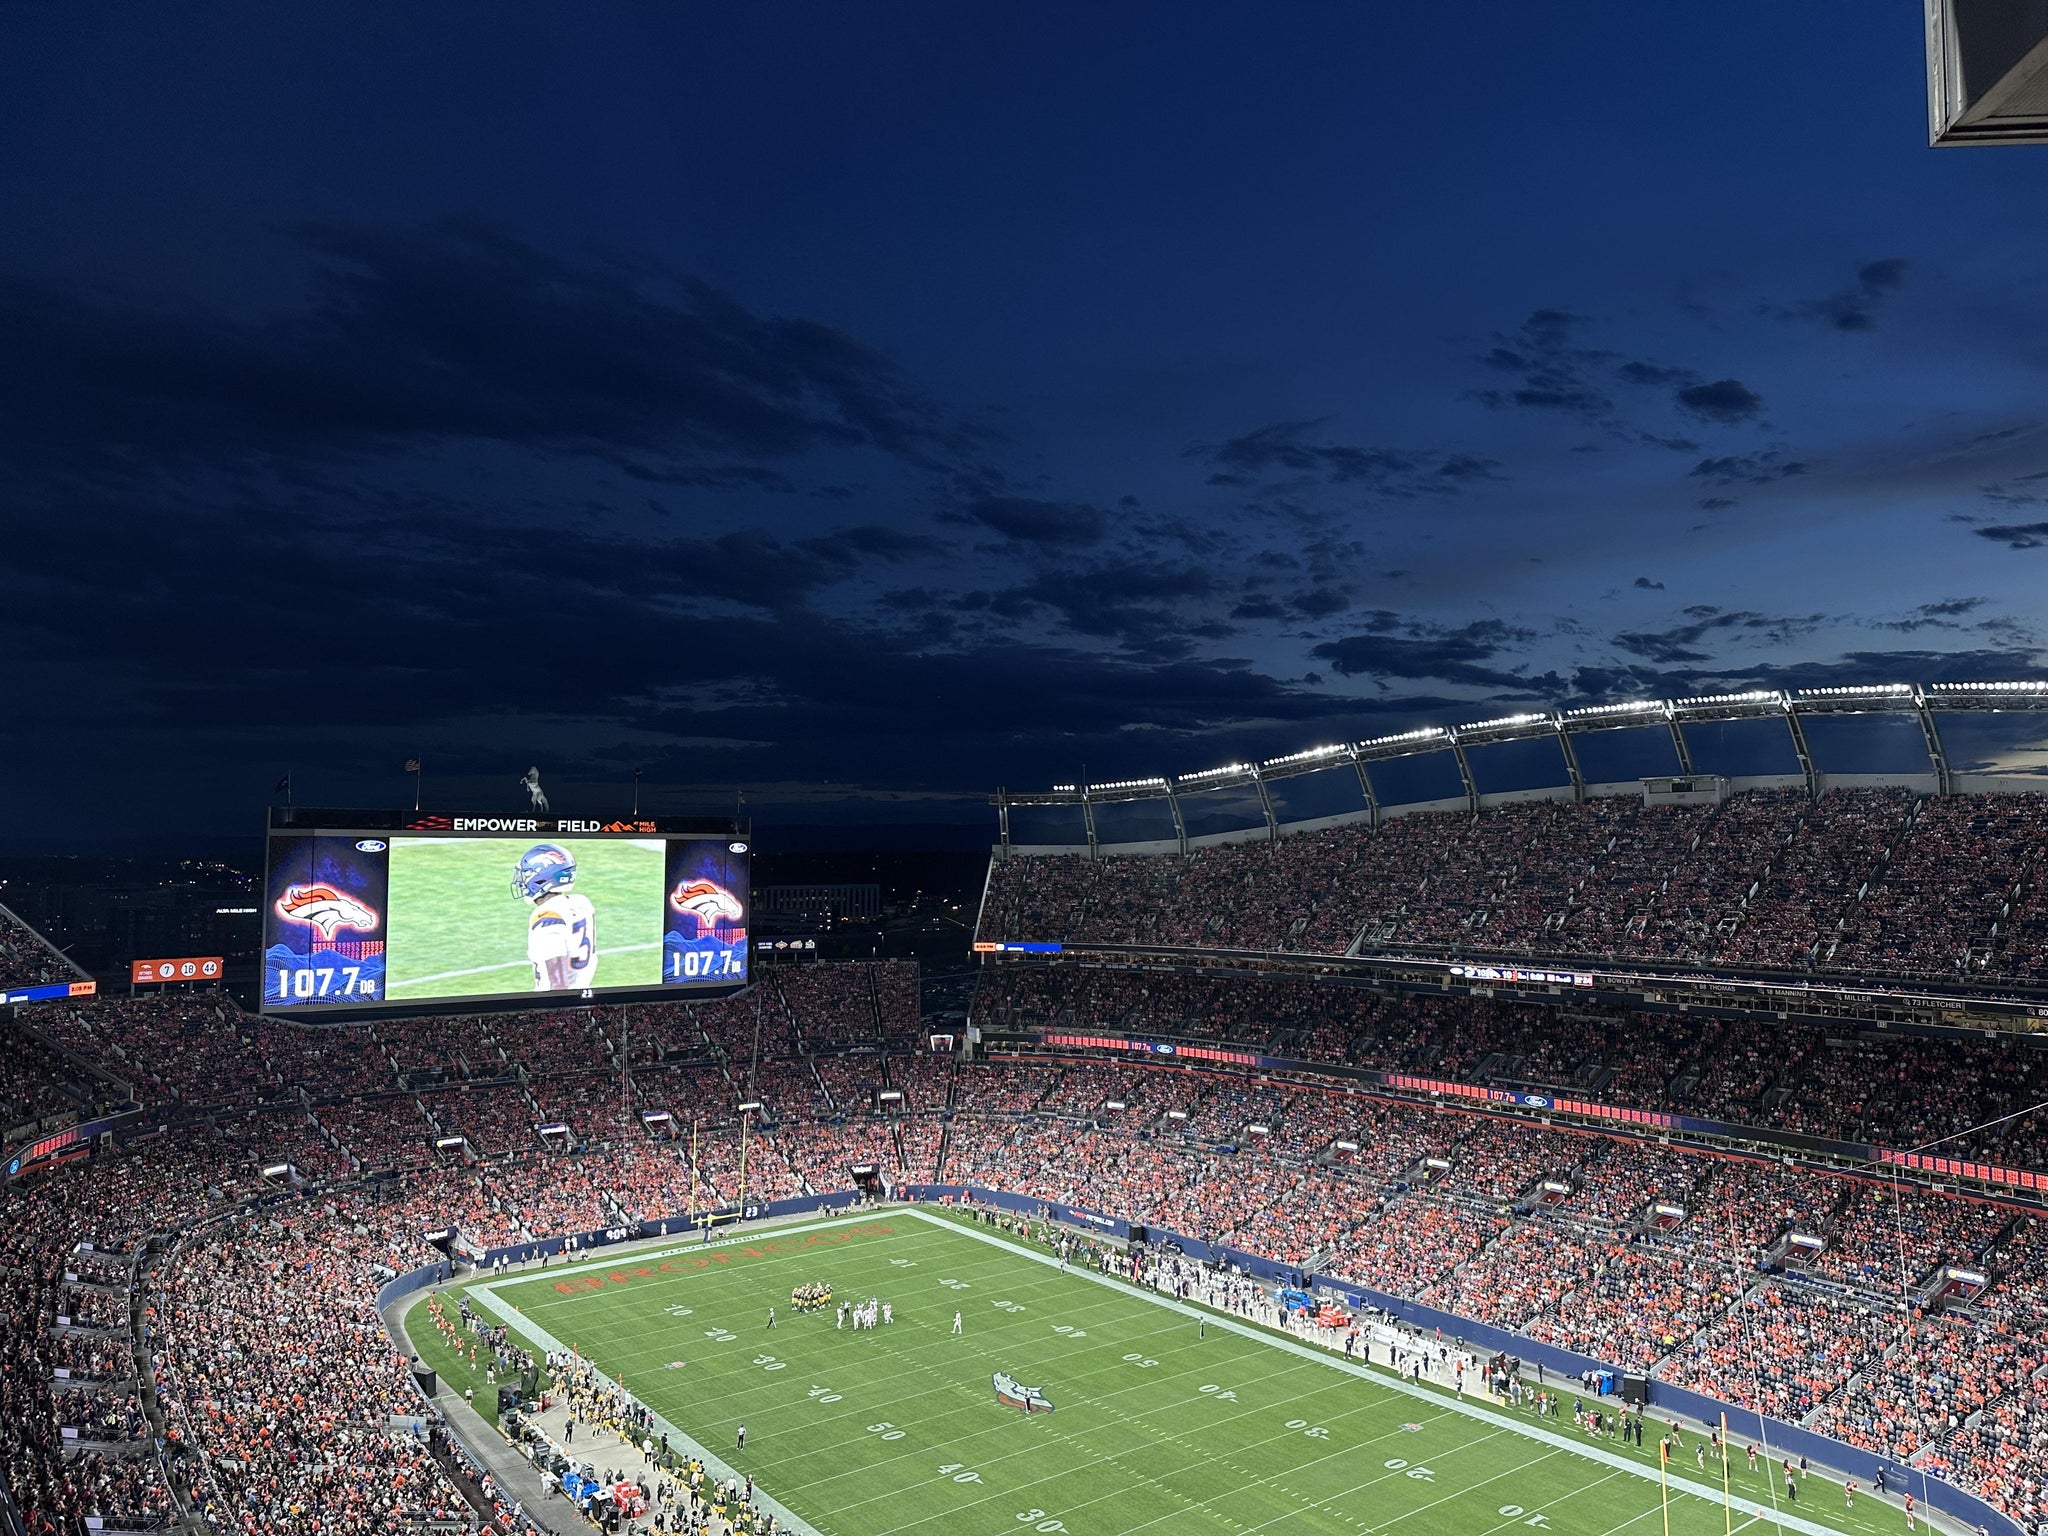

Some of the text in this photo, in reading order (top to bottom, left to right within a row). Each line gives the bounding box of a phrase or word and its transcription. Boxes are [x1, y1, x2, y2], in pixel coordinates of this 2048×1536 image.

[454, 818, 600, 832] EMPOWER FIELD
[184, 965, 194, 974] 18
[204, 963, 215, 972] 44
[673, 950, 732, 976] 107.7
[164, 965, 170, 975] 7
[280, 967, 376, 998] 107.7 DB
[1607, 977, 1635, 985] BOWLEN
[581, 989, 592, 998] 23
[1709, 984, 1736, 992] THOMAS
[1775, 990, 1807, 998] MANNING
[1844, 994, 1872, 1002] MILLER
[1922, 1000, 1962, 1009] FLETCHER
[1489, 1090, 1510, 1101] 107.7
[746, 1206, 758, 1217] 23
[606, 1228, 627, 1240] 9:09
[551, 1223, 894, 1295] BRONCOS
[664, 1304, 693, 1316] 10
[993, 1300, 1026, 1312] 30
[704, 1327, 737, 1343] 20
[1053, 1325, 1087, 1338] 40
[753, 1355, 787, 1371] 30
[1122, 1353, 1160, 1369] 50
[807, 1387, 843, 1403] 40
[1198, 1384, 1237, 1400] 40
[866, 1422, 906, 1441] 50
[1285, 1419, 1329, 1438] 30
[936, 1462, 980, 1484] 40
[1384, 1458, 1434, 1480] 20
[1016, 1508, 1065, 1534] 30
[1498, 1505, 1547, 1528] 10
